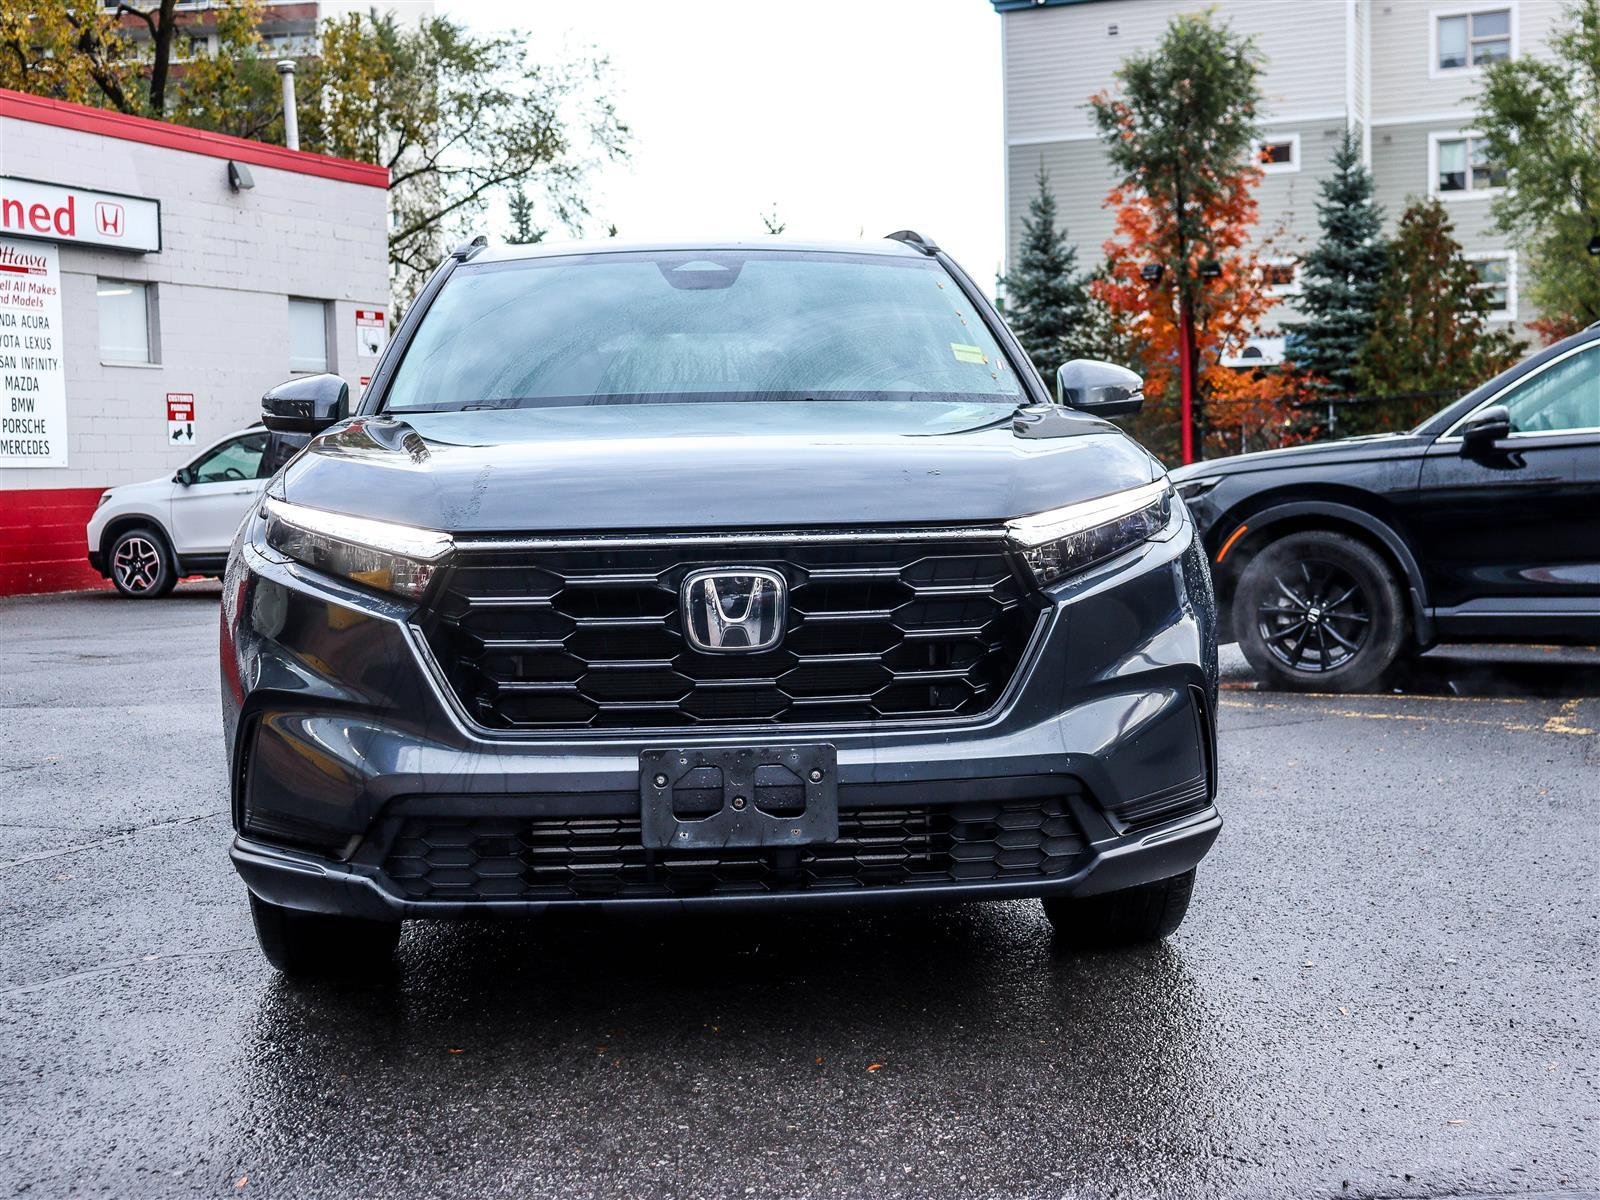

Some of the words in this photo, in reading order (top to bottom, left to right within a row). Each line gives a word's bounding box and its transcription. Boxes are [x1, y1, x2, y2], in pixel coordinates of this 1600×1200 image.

[0, 246, 47, 267] ttawa
[13, 281, 26, 293] All
[28, 282, 57, 296] Makes
[12, 294, 44, 308] Models
[21, 315, 50, 329] ACURA
[24, 336, 52, 351] LEXUS
[21, 356, 58, 371] INFINITY
[5, 375, 39, 391] MAZDA
[11, 397, 35, 413] BMW
[2, 418, 46, 433] PORSCHE
[0, 439, 50, 455] MERCEDES
